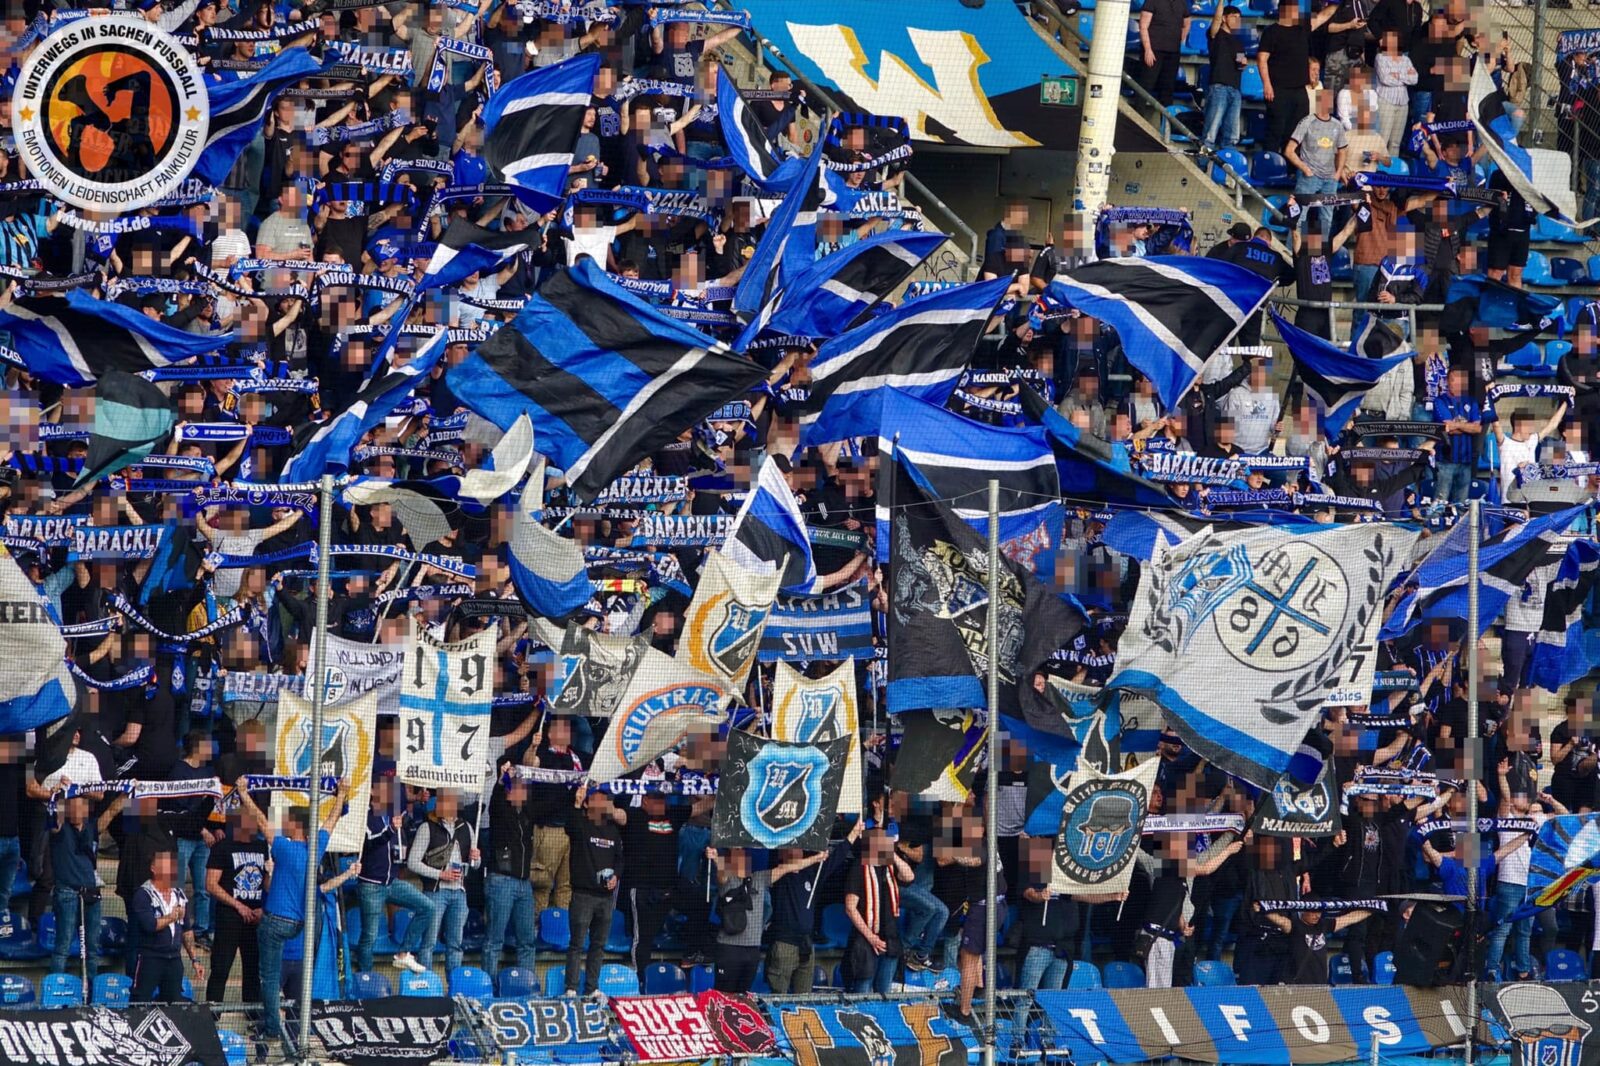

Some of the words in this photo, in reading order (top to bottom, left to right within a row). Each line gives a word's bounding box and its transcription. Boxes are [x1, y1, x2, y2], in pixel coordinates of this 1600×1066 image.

[1246, 249, 1276, 266] 1907
[197, 488, 244, 507] S.E.K.
[782, 632, 839, 656] SVW
[1396, 677, 1409, 687] MIT
[456, 724, 481, 762] 7
[405, 766, 479, 786] Mannheim
[153, 782, 166, 792] SV
[167, 780, 200, 792] Waldhof
[608, 781, 650, 795] ULT
[1261, 817, 1333, 834] MANNHEIM
[489, 1000, 609, 1048] SBE
[615, 997, 708, 1036] SUPS
[633, 1033, 721, 1061] WORMS
